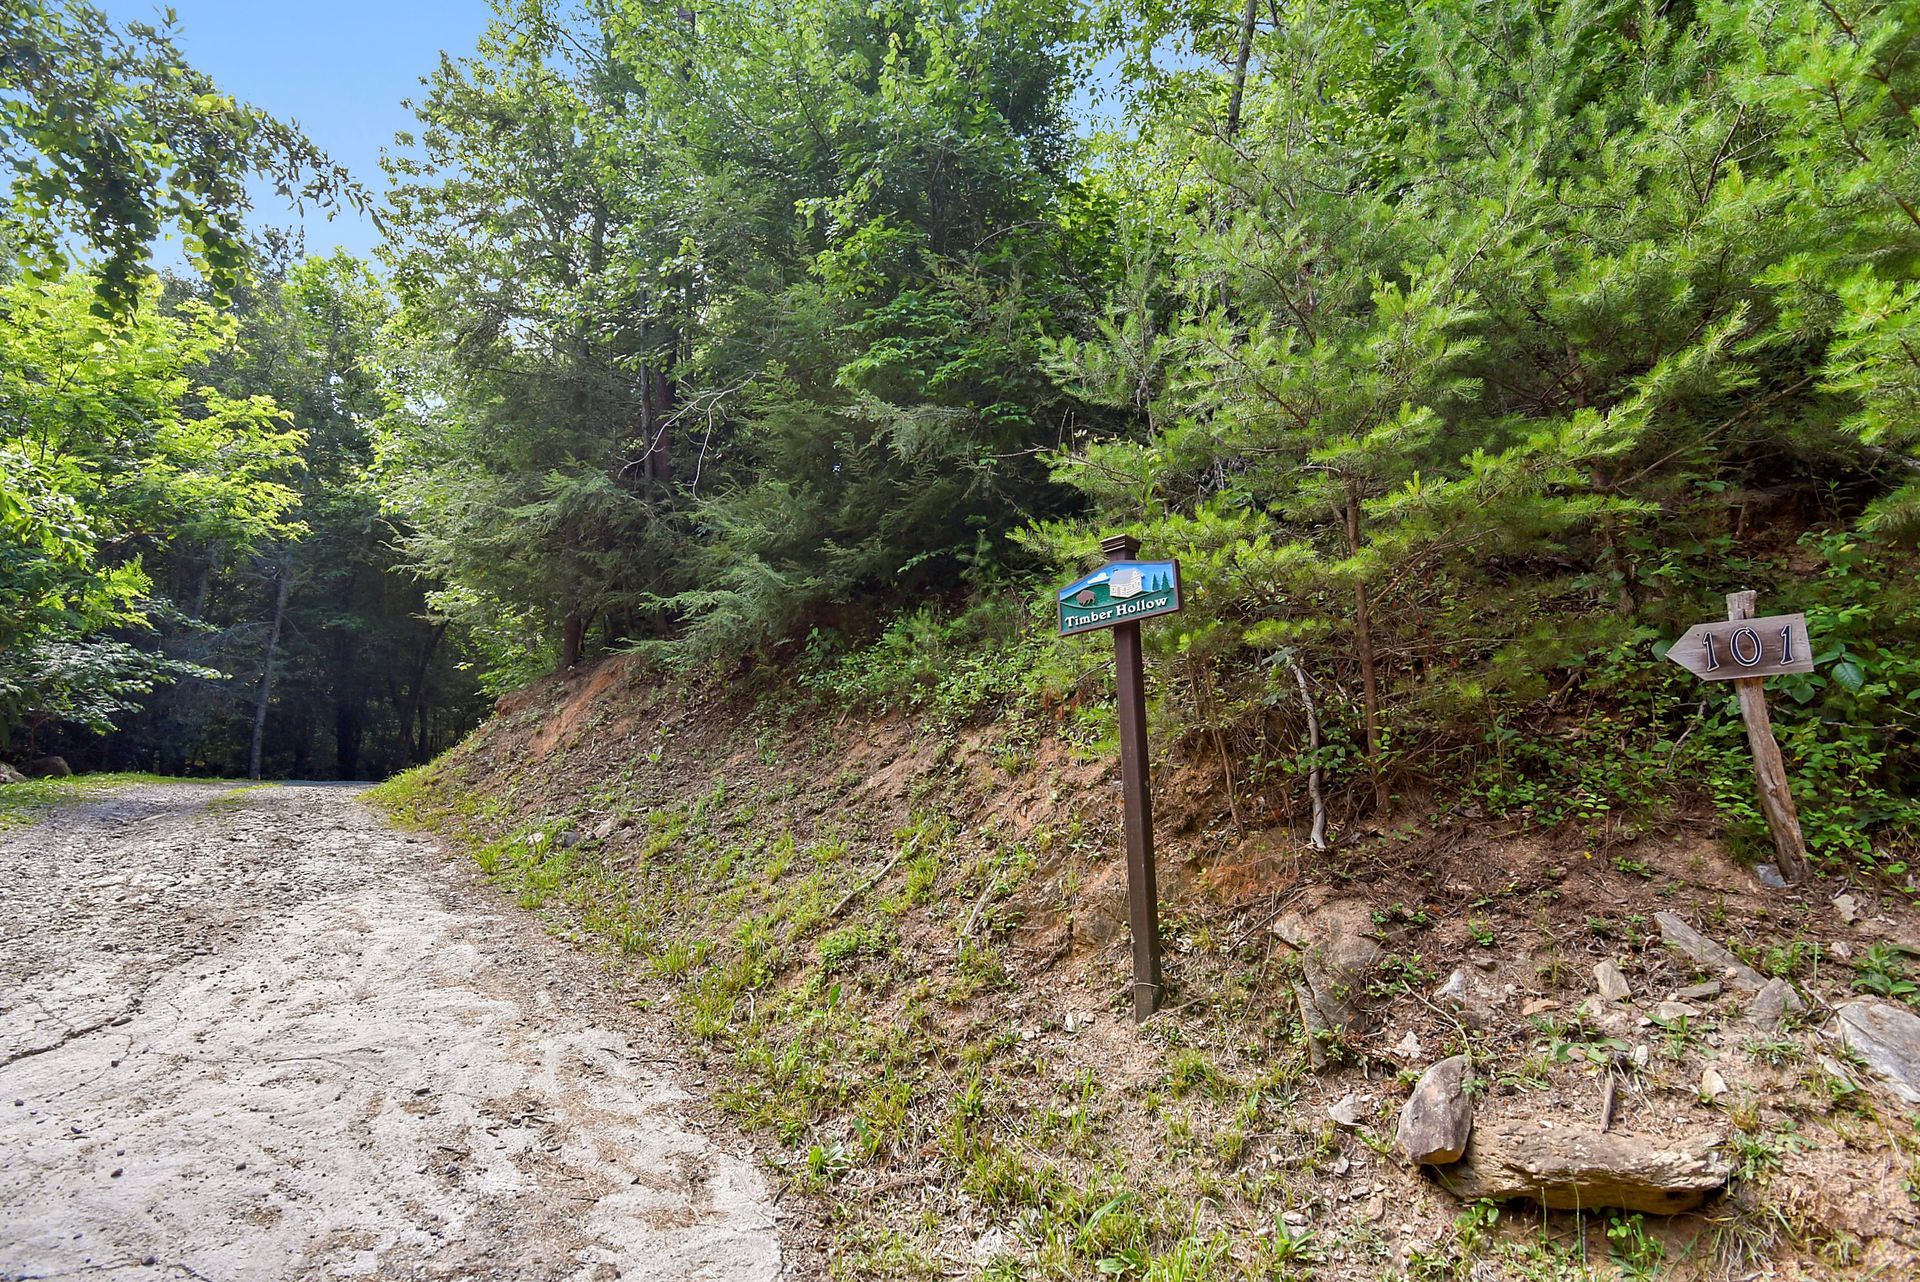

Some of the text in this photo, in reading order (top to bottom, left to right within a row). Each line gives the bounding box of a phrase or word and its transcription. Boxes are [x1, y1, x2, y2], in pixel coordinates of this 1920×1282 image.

[1065, 598, 1168, 627] Timber Hollow
[1703, 624, 1794, 672] 101
